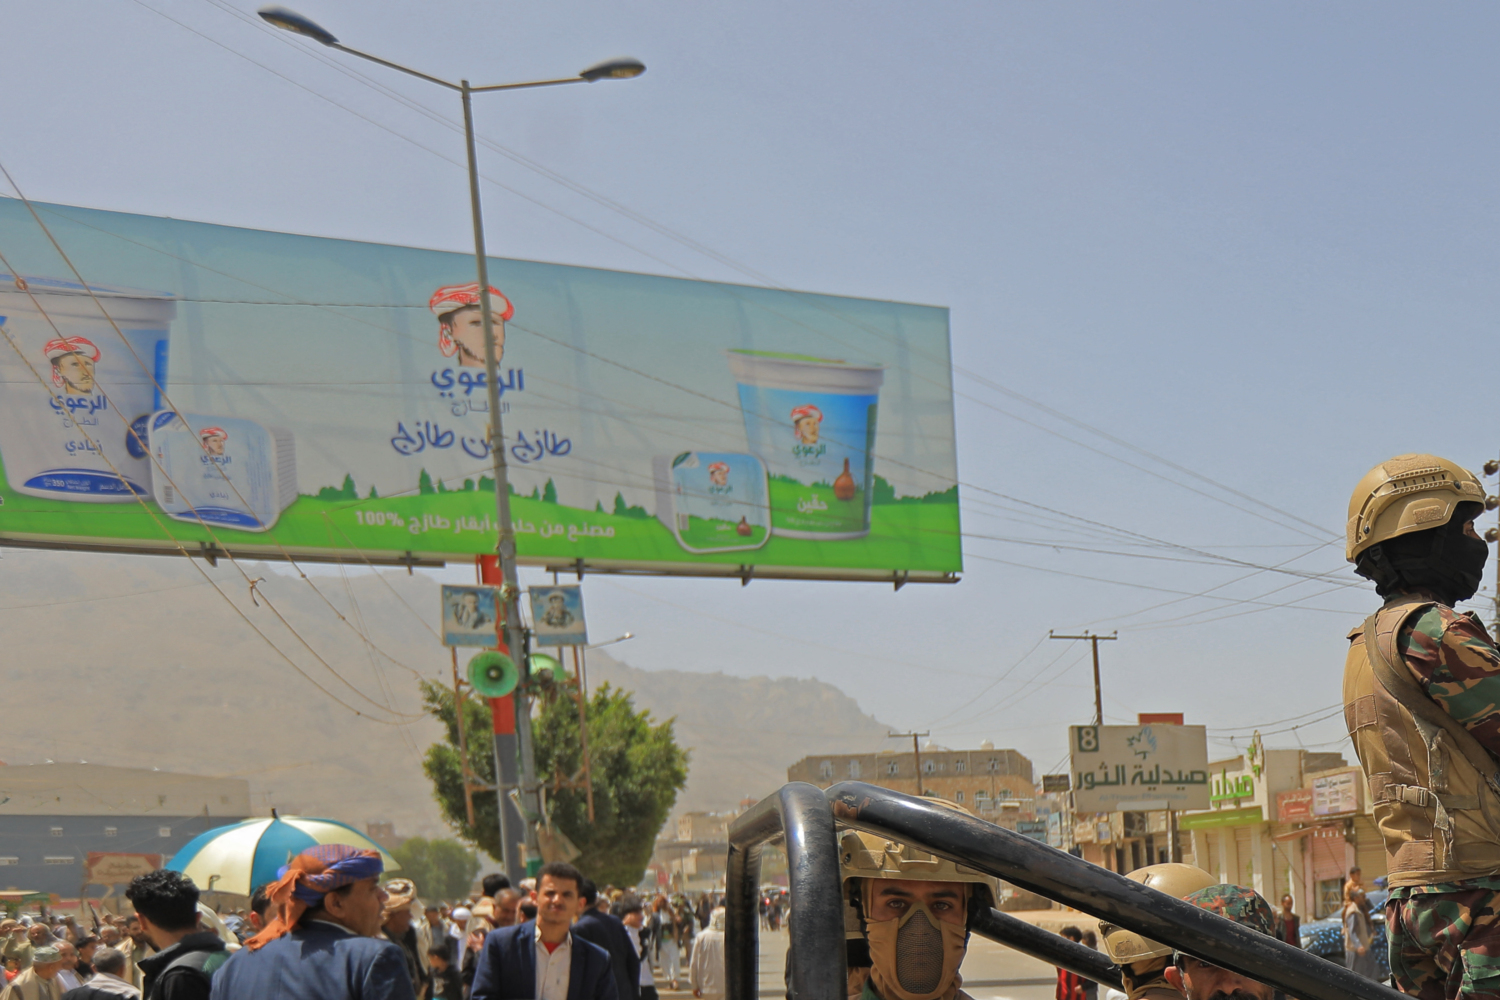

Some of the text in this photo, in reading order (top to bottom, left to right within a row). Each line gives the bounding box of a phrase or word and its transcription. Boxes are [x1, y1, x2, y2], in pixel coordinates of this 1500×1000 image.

[431, 368, 525, 398] الرعوي
[50, 395, 107, 415] الرعوي
[65, 440, 103, 456] زبادي
[391, 420, 455, 455] طازج
[512, 430, 572, 464] طازج
[797, 493, 828, 514] حقين
[355, 510, 405, 527] 100%
[408, 512, 451, 535] طازج
[540, 519, 565, 538] من
[1081, 727, 1097, 750] 8
[1076, 761, 1126, 790] الثور
[1131, 764, 1207, 791] صيدلية
[1208, 768, 1253, 808] صيدلي
